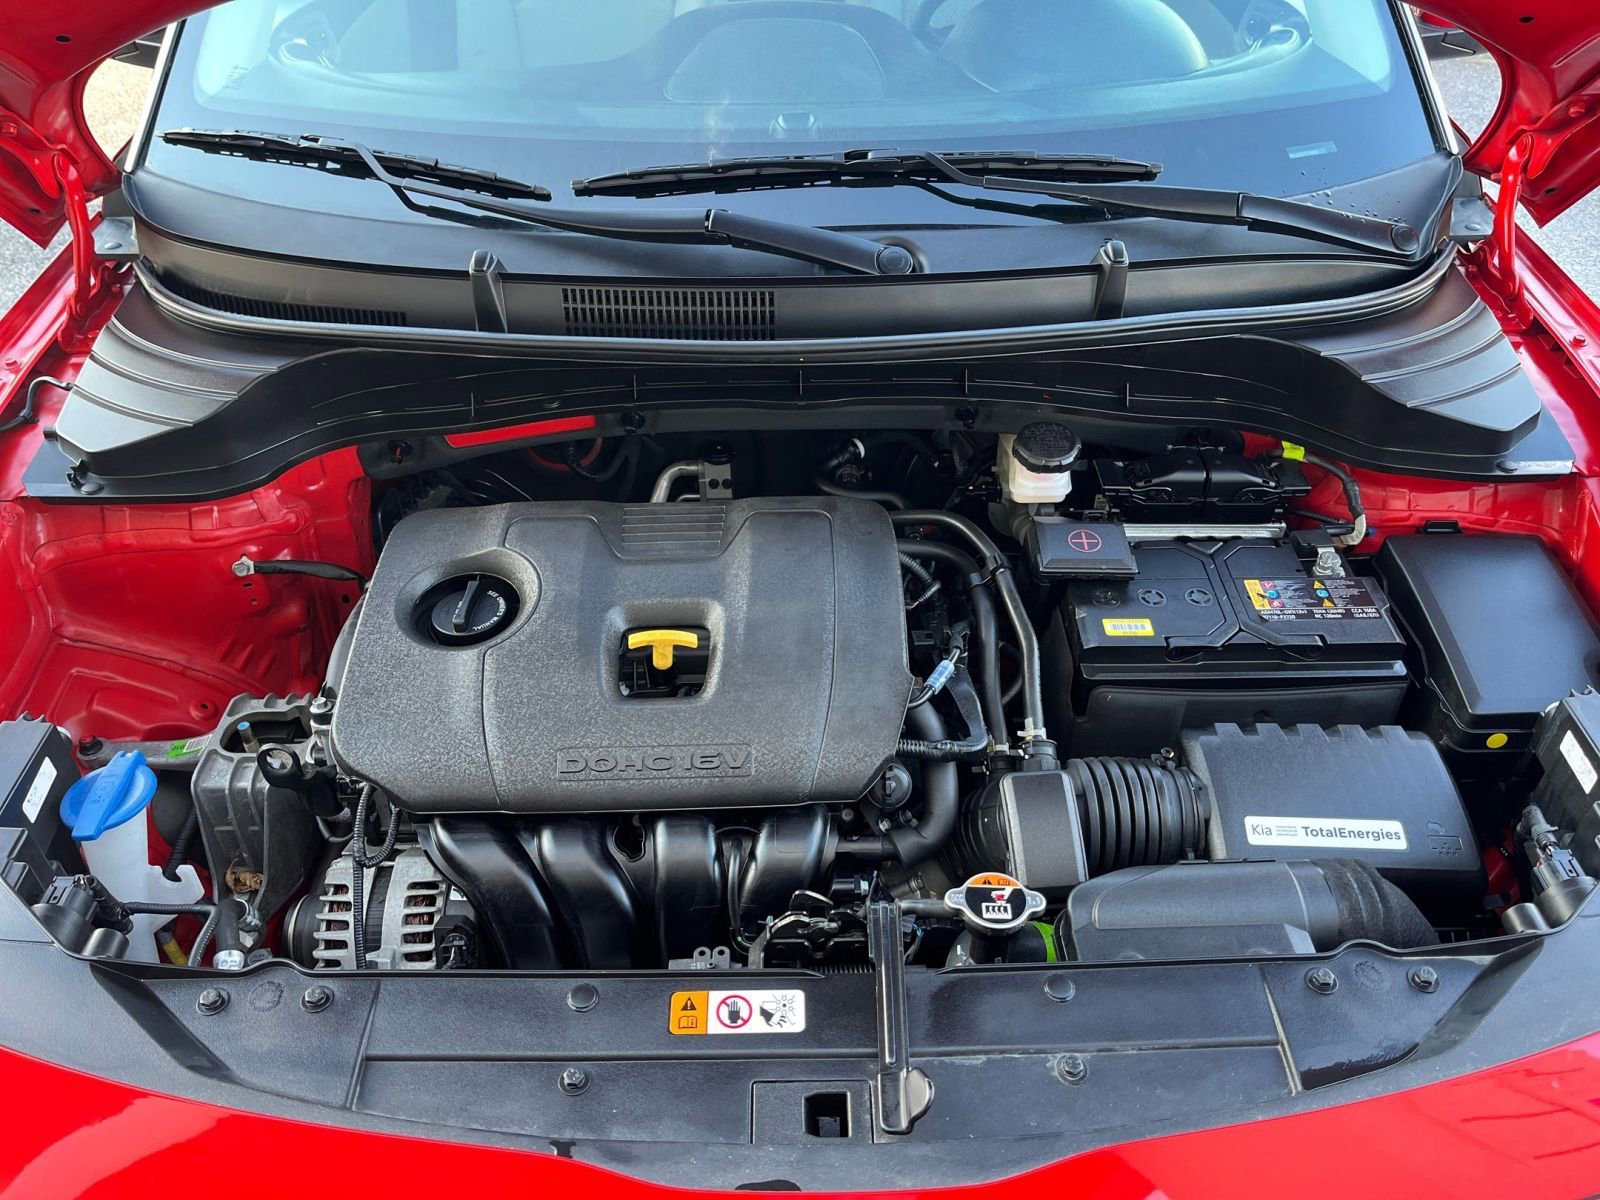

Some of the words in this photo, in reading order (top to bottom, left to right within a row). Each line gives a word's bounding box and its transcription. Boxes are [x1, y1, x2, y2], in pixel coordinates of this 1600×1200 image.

[472, 616, 499, 631] MANUAL
[559, 754, 673, 774] DOHC
[684, 750, 750, 771] 16V
[1251, 824, 1273, 836] Kia
[1301, 826, 1401, 841] TotalEnergies
